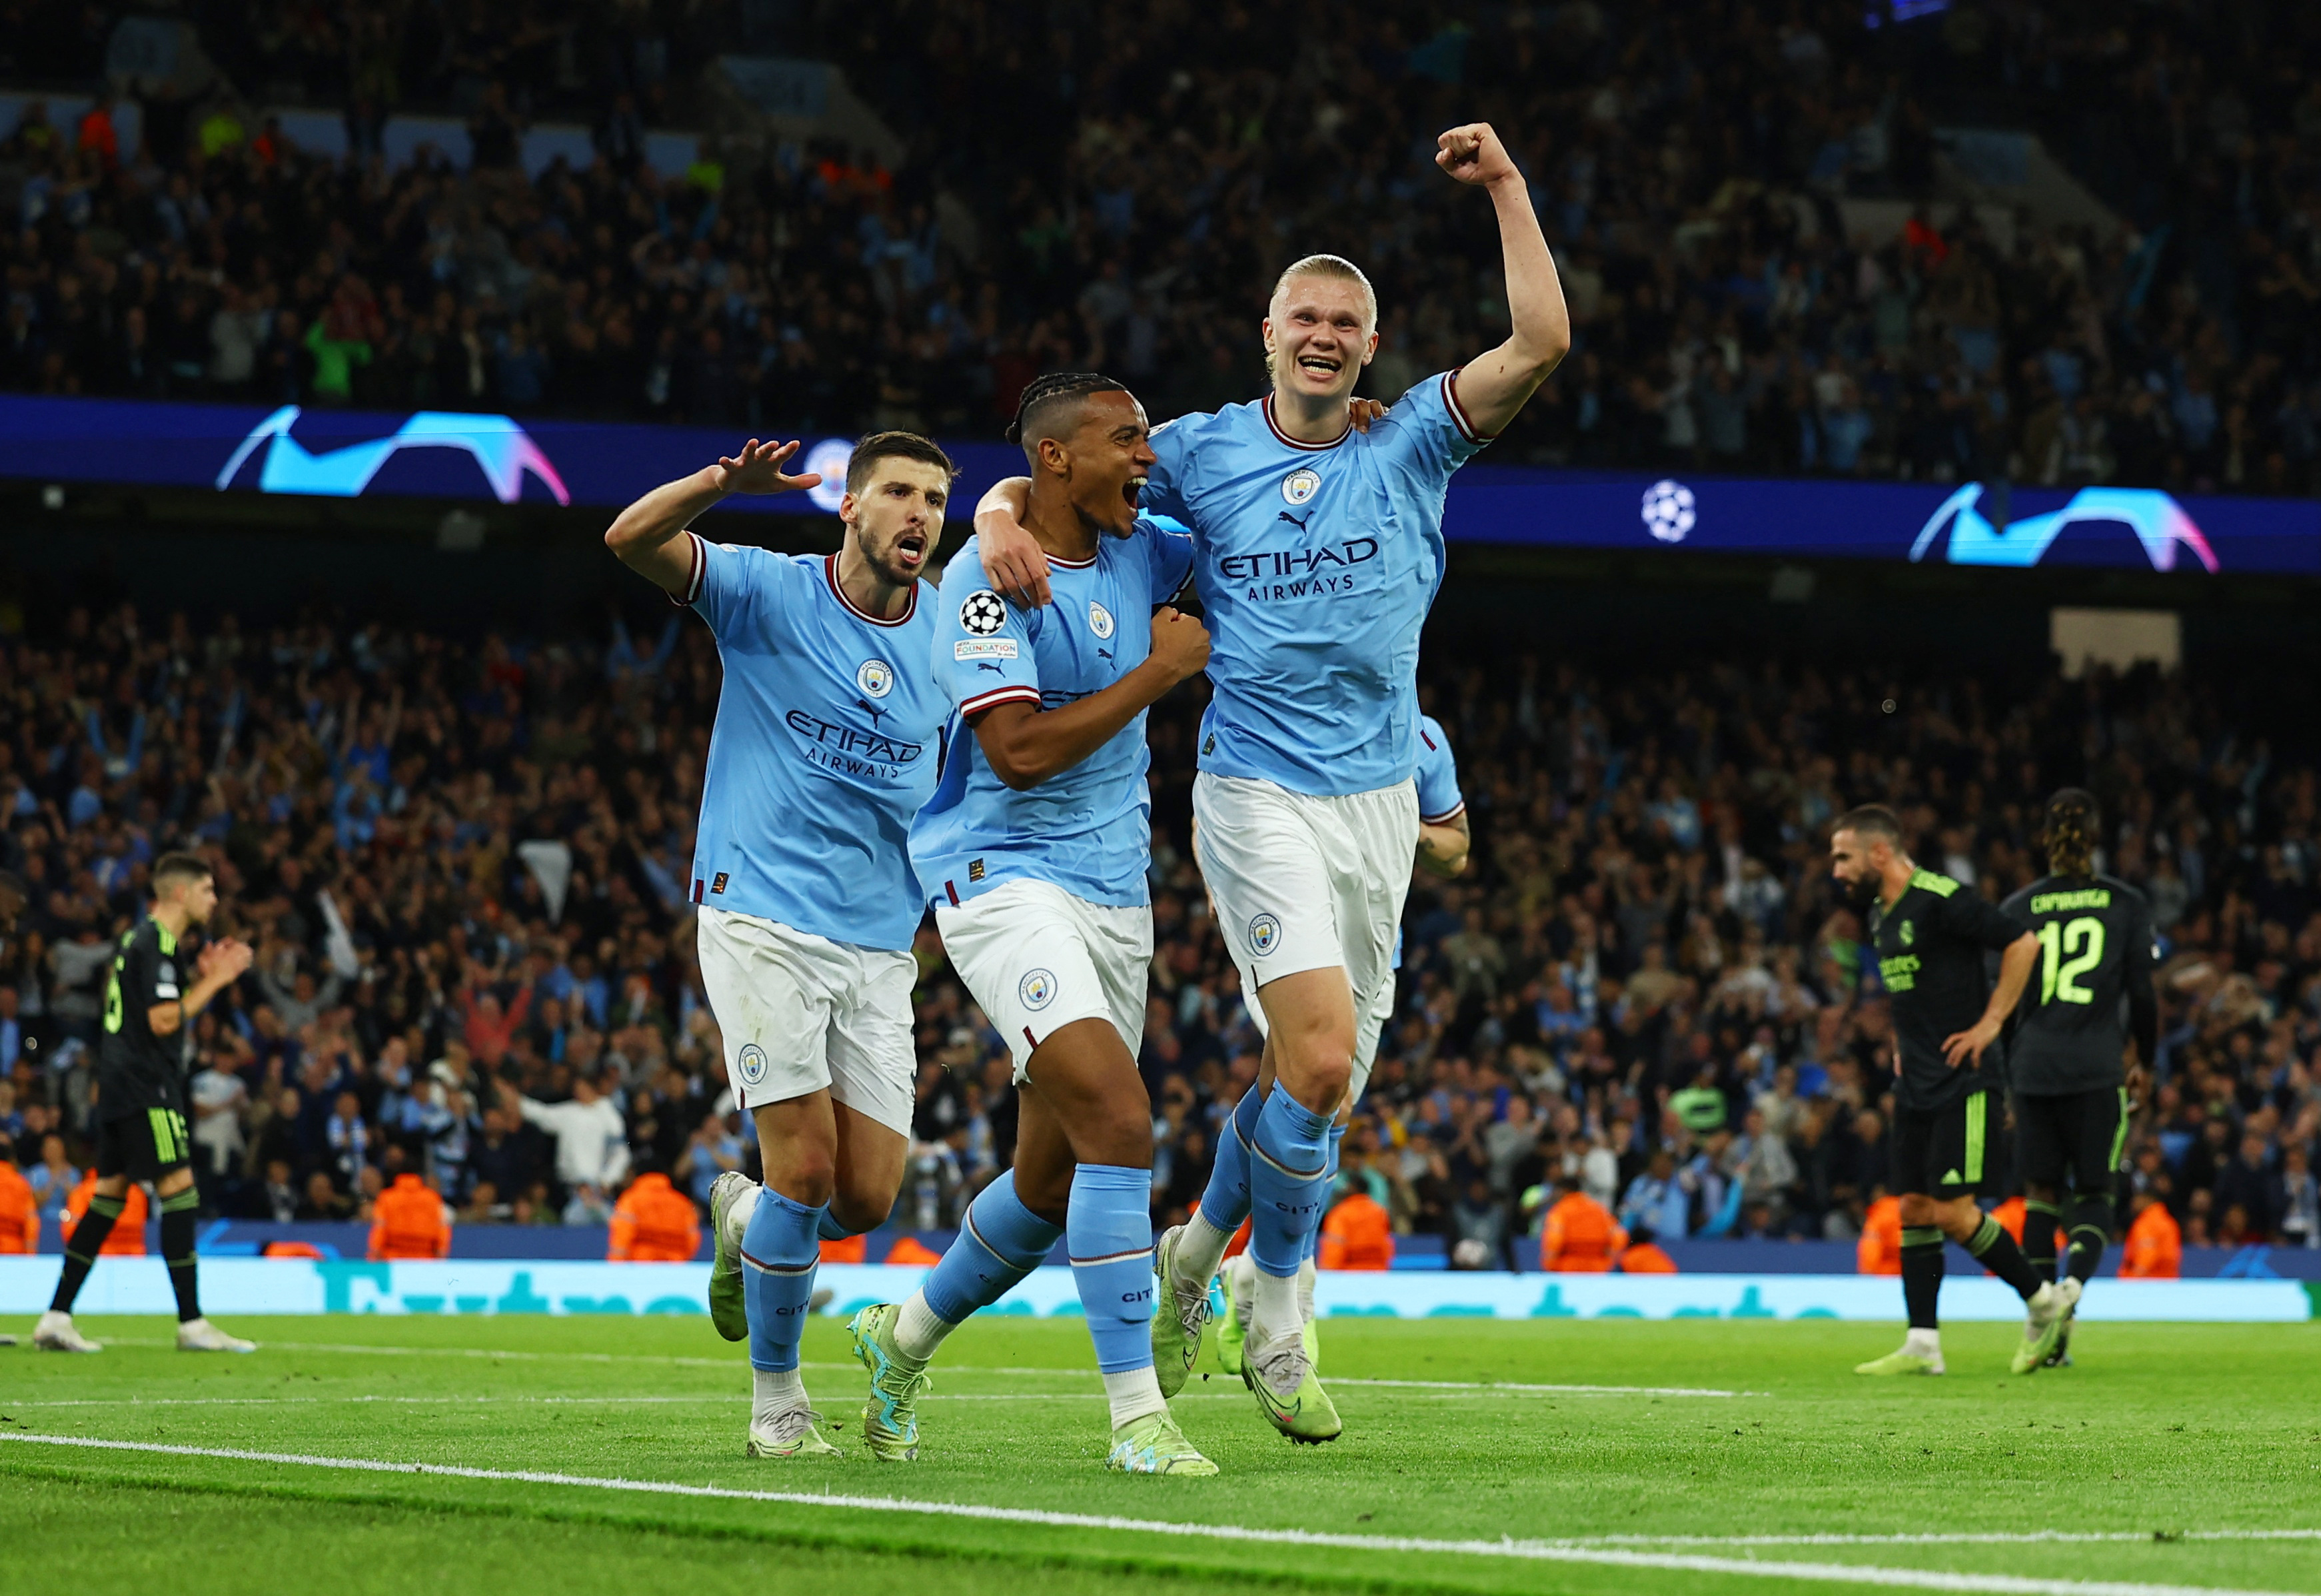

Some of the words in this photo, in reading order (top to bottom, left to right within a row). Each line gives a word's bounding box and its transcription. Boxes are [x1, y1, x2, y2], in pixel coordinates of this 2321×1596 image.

[1287, 470, 1319, 484] MANCHESTER
[1220, 538, 1379, 579] ETIHAD
[1247, 574, 1353, 602] AIRWAYS
[956, 644, 1016, 654] FOUNDATION
[862, 661, 891, 676] MANCHESTER
[786, 710, 922, 762] ETIHAD
[805, 747, 899, 778] AIRWAYS
[1251, 916, 1276, 934] MANCHESTER
[2037, 916, 2105, 1006] 12
[1122, 1287, 1153, 1303] CIT
